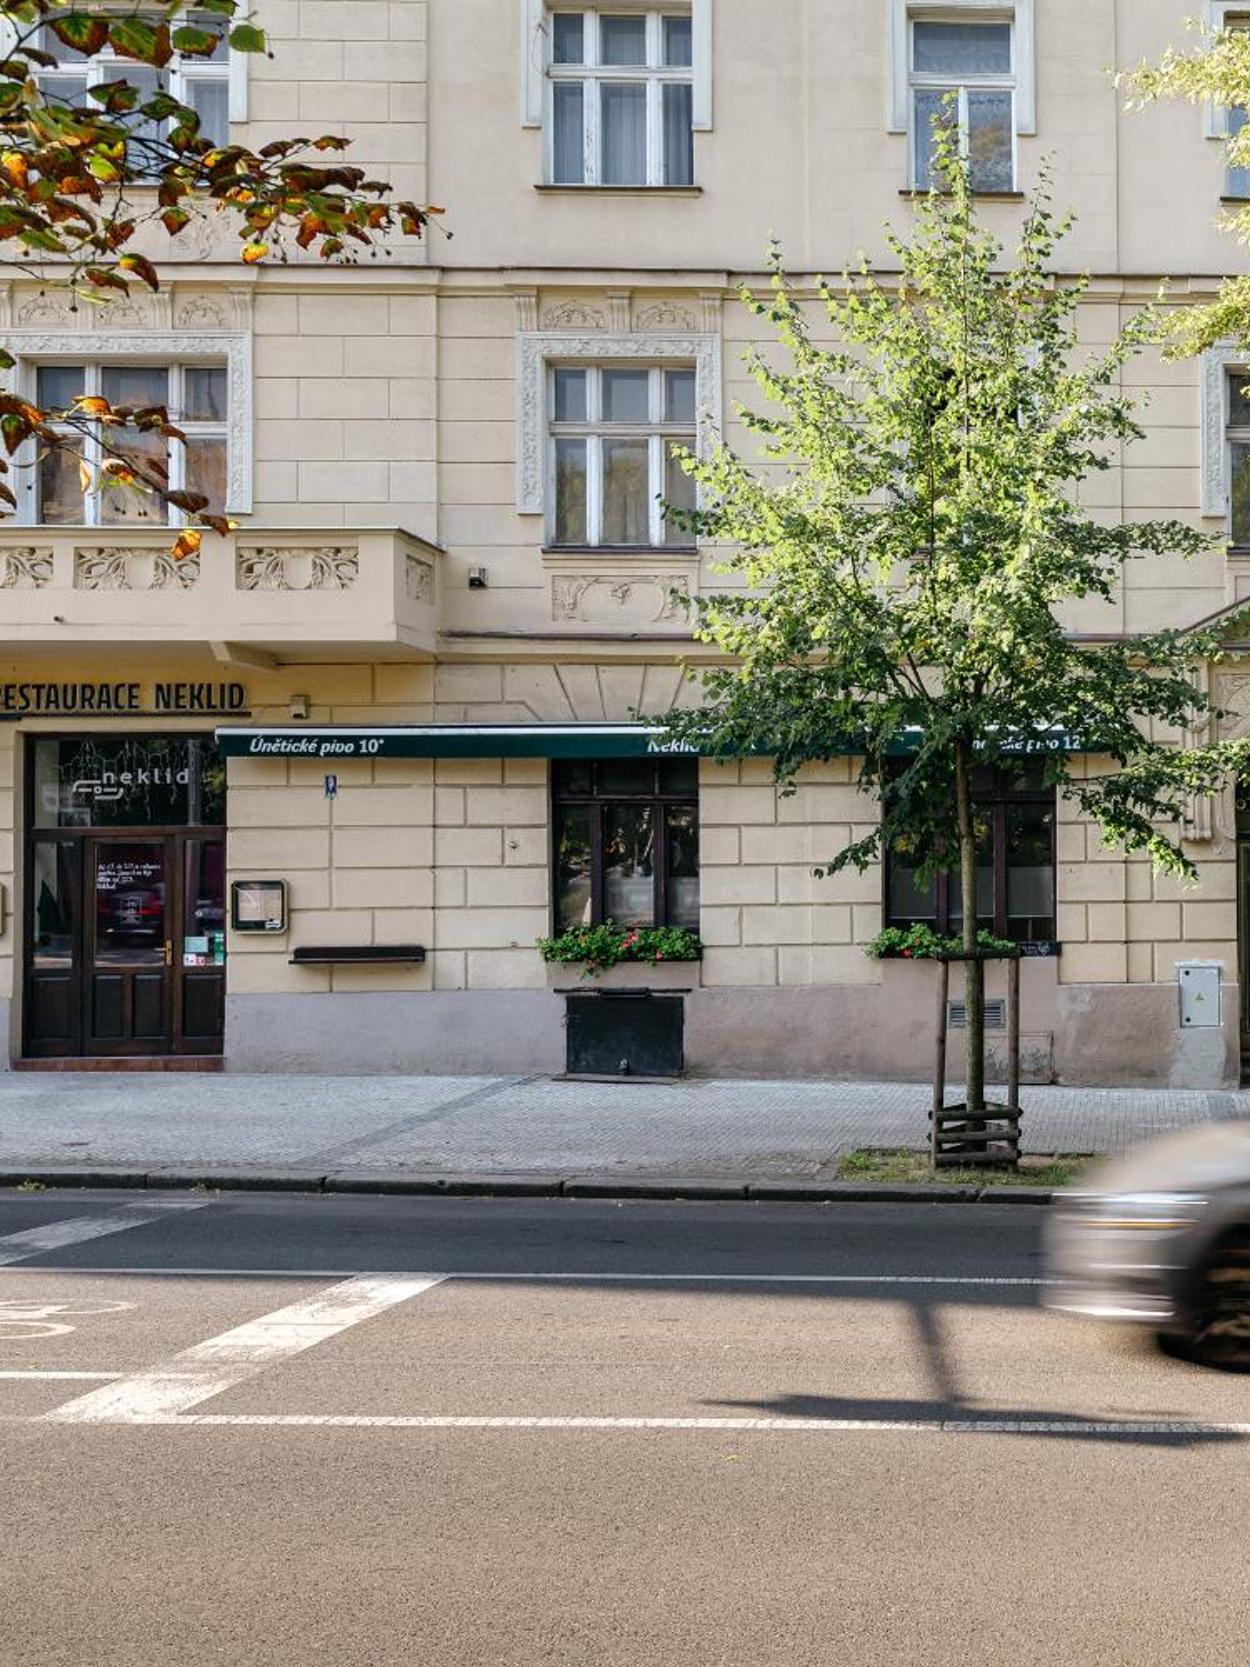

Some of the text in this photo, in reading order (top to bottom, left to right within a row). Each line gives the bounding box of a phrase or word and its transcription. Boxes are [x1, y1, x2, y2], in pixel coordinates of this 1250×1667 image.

[0, 683, 244, 710] ESTAURACE NEKLID
[249, 735, 318, 753] Únětické
[319, 740, 355, 756] pivo
[102, 767, 189, 785] neklid
